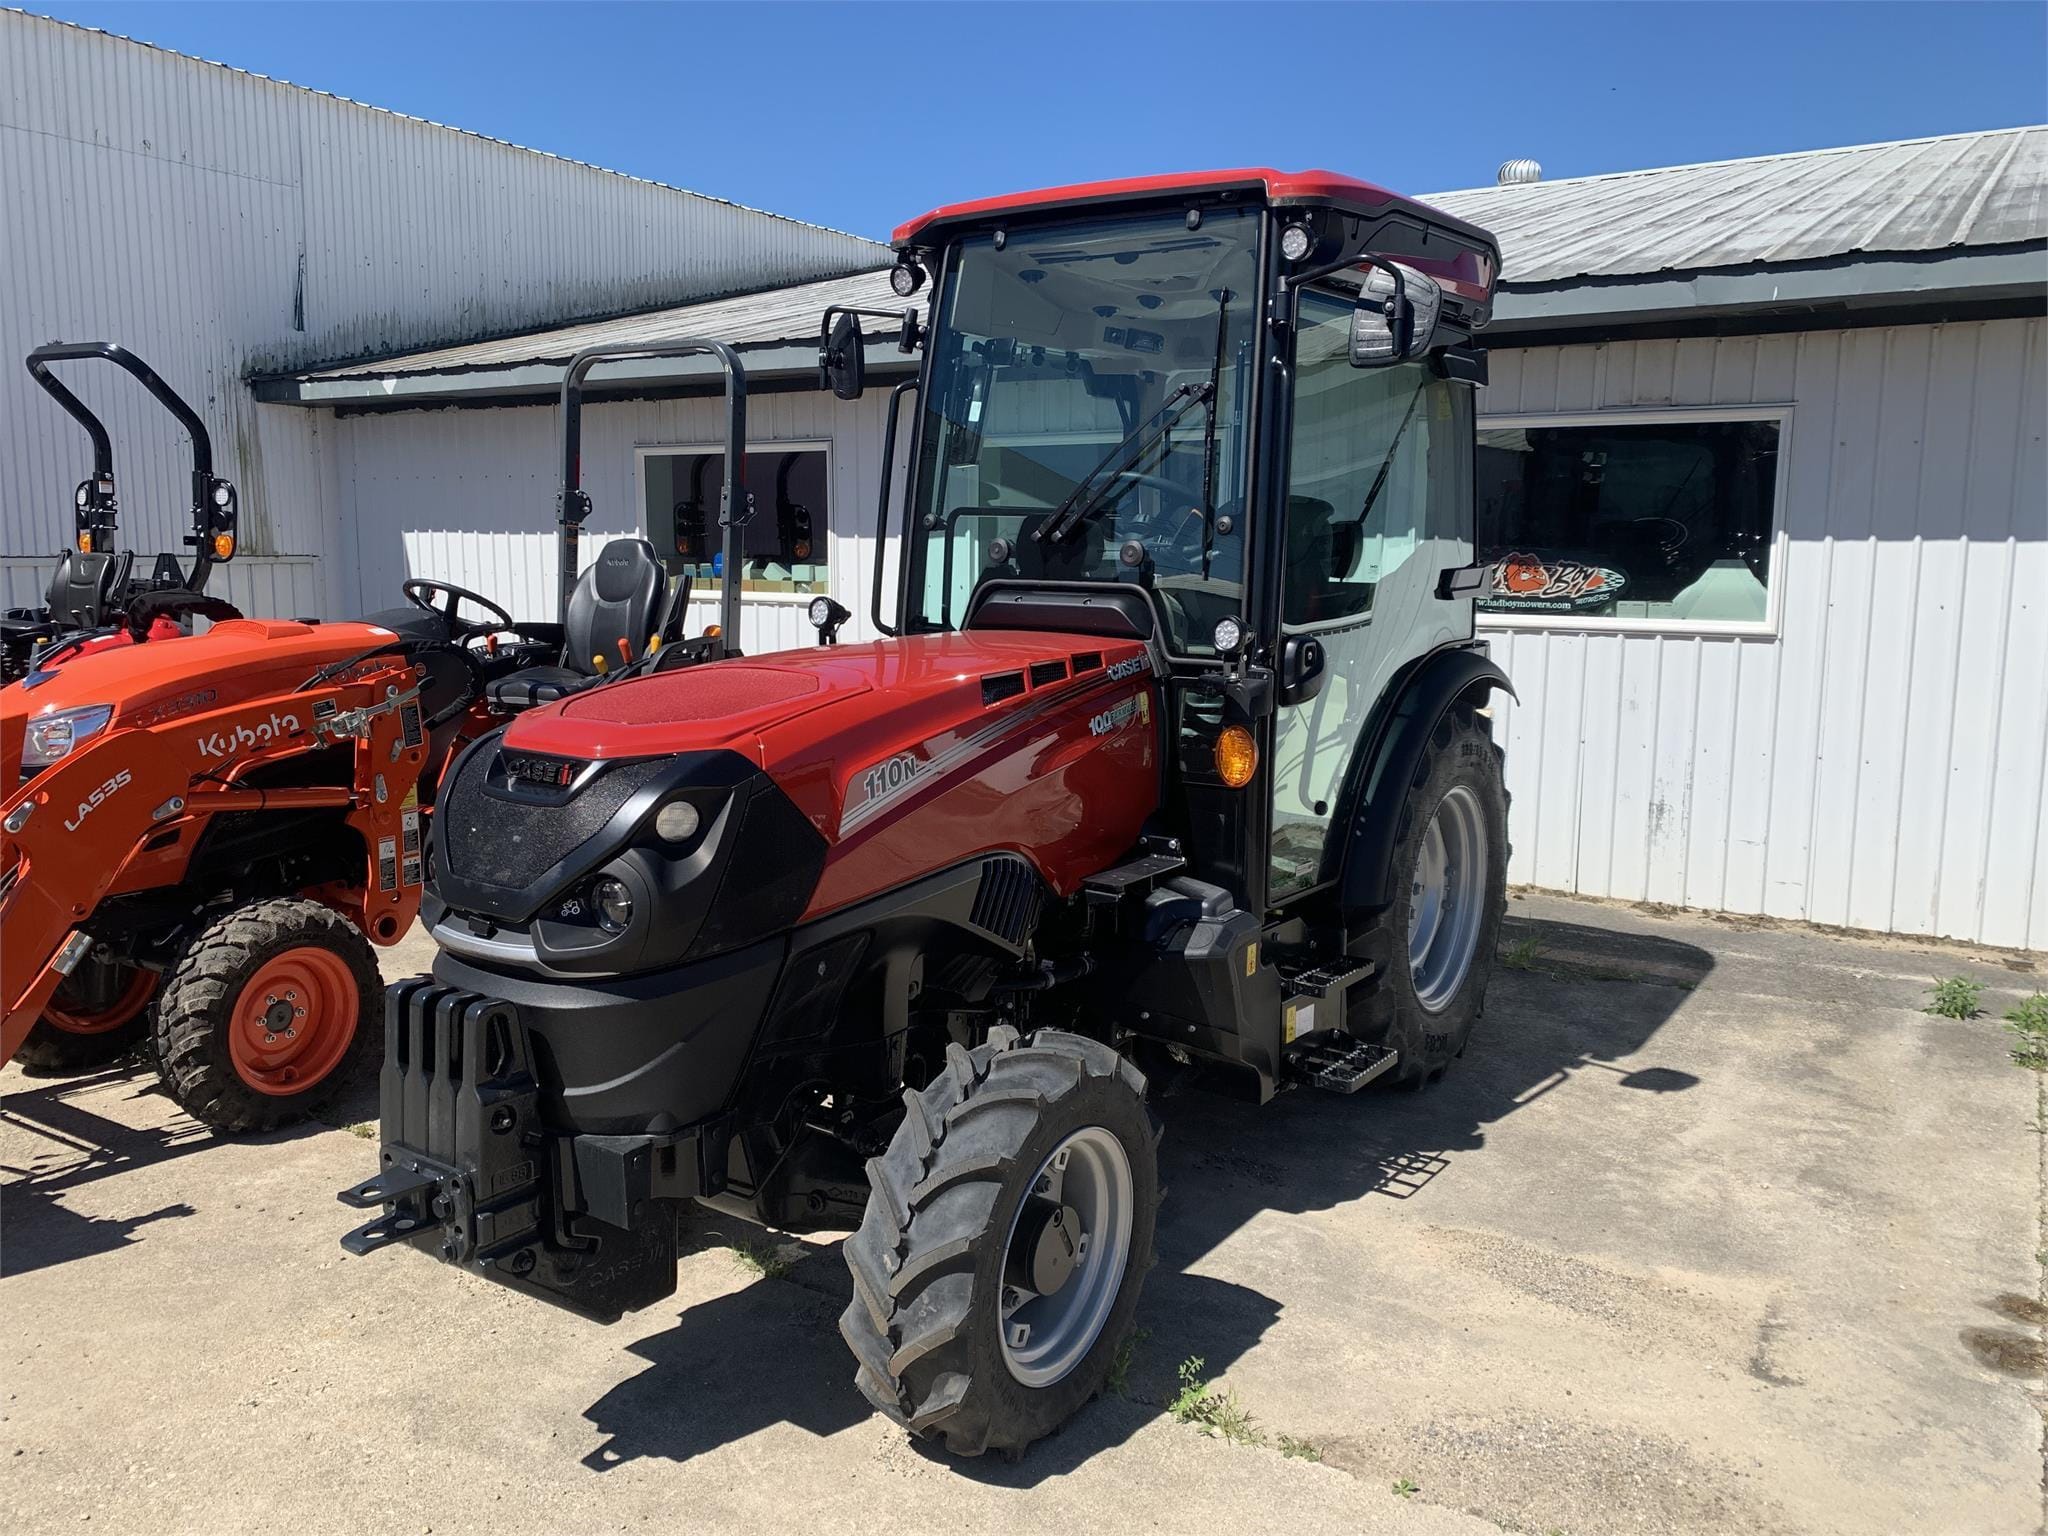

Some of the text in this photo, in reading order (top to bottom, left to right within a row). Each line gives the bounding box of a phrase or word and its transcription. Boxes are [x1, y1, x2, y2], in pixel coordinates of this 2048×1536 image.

[1540, 560, 1597, 598] Boy
[1477, 599, 1572, 609] w.badboymowers.com
[1107, 657, 1140, 680] CASE
[198, 713, 300, 757] Kubota
[507, 760, 556, 783] CASE
[64, 769, 132, 832] LA535
